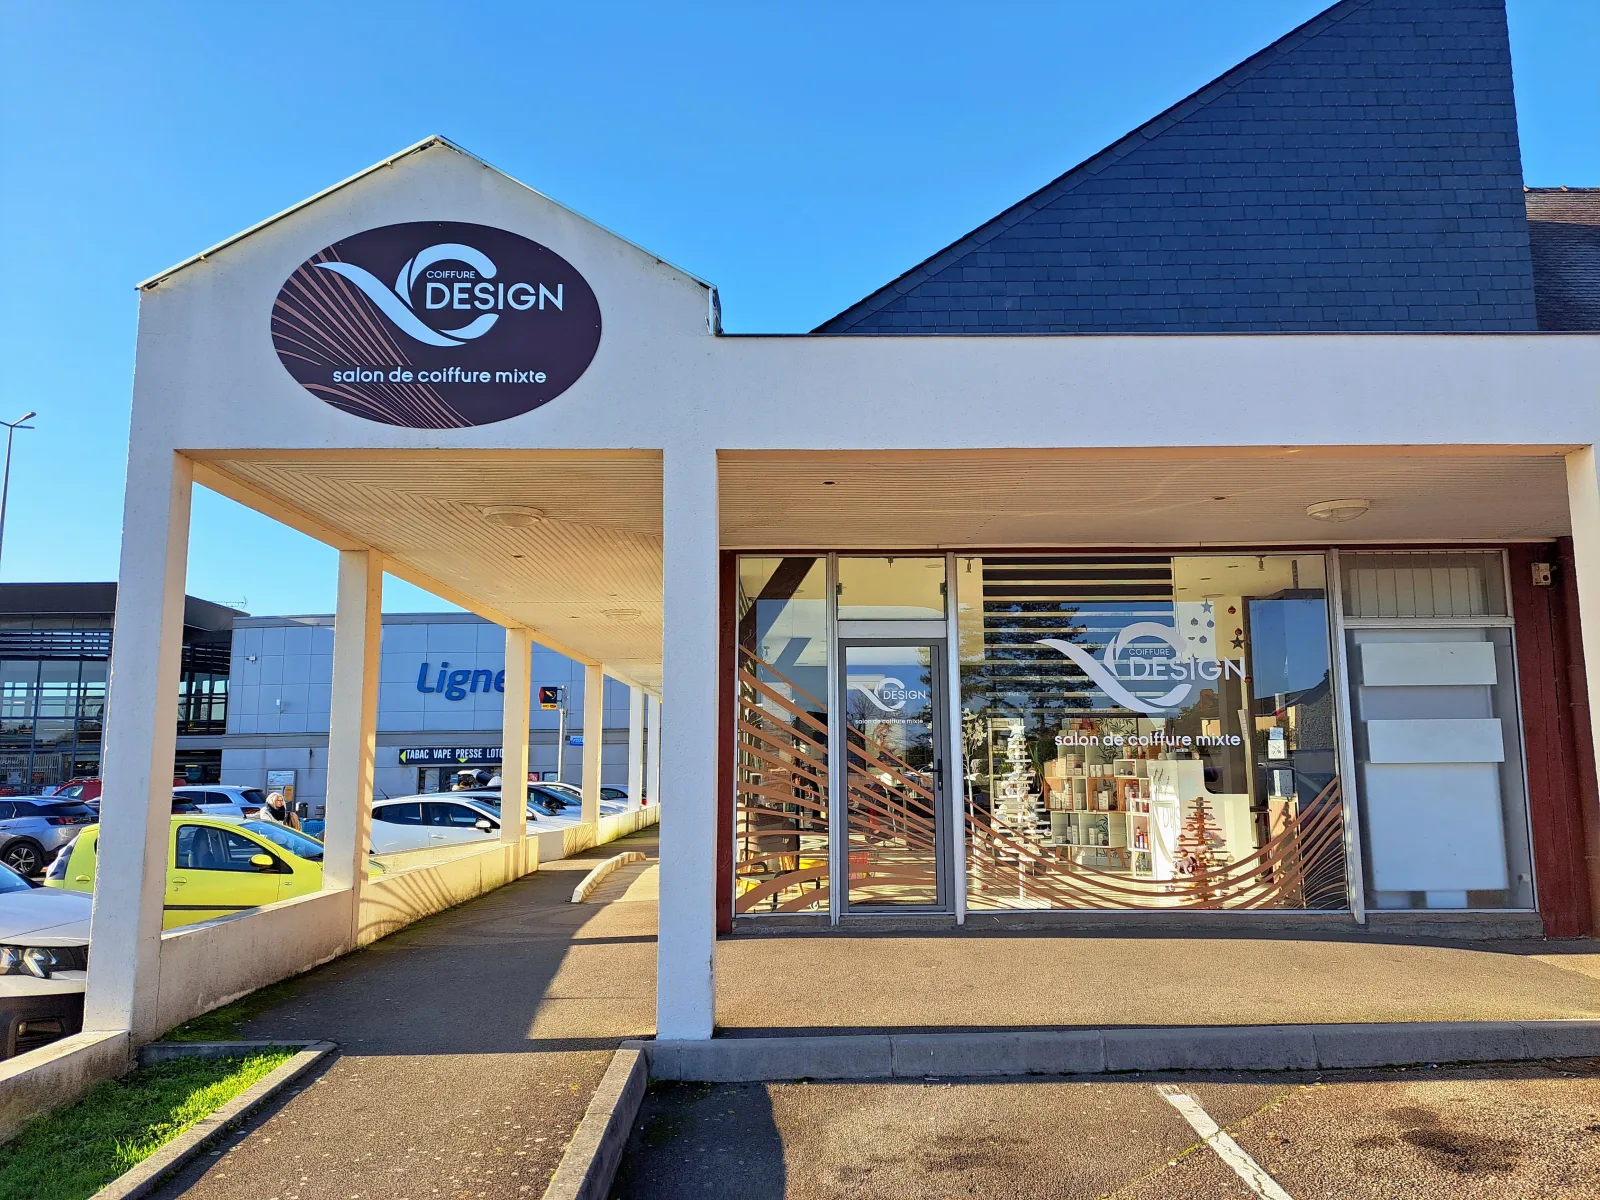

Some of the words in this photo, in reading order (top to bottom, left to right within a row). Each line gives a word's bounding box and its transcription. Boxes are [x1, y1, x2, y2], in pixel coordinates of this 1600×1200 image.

[426, 270, 476, 279] COIFFURE
[425, 282, 563, 311] DESIGN
[332, 366, 384, 383] salon
[388, 366, 414, 383] de
[417, 366, 491, 383] coiffure
[495, 368, 547, 384] mixte
[1128, 648, 1171, 656] COIFFURE
[1129, 656, 1247, 680] DESIGN
[883, 690, 926, 700] DESIGN
[1054, 731, 1099, 747] salon
[1102, 731, 1125, 747] de
[1128, 731, 1192, 747] coiffure
[1195, 733, 1241, 747] mixte
[406, 749, 429, 760] TABAC
[433, 749, 452, 759] VAPE
[455, 748, 483, 759] PRESSE
